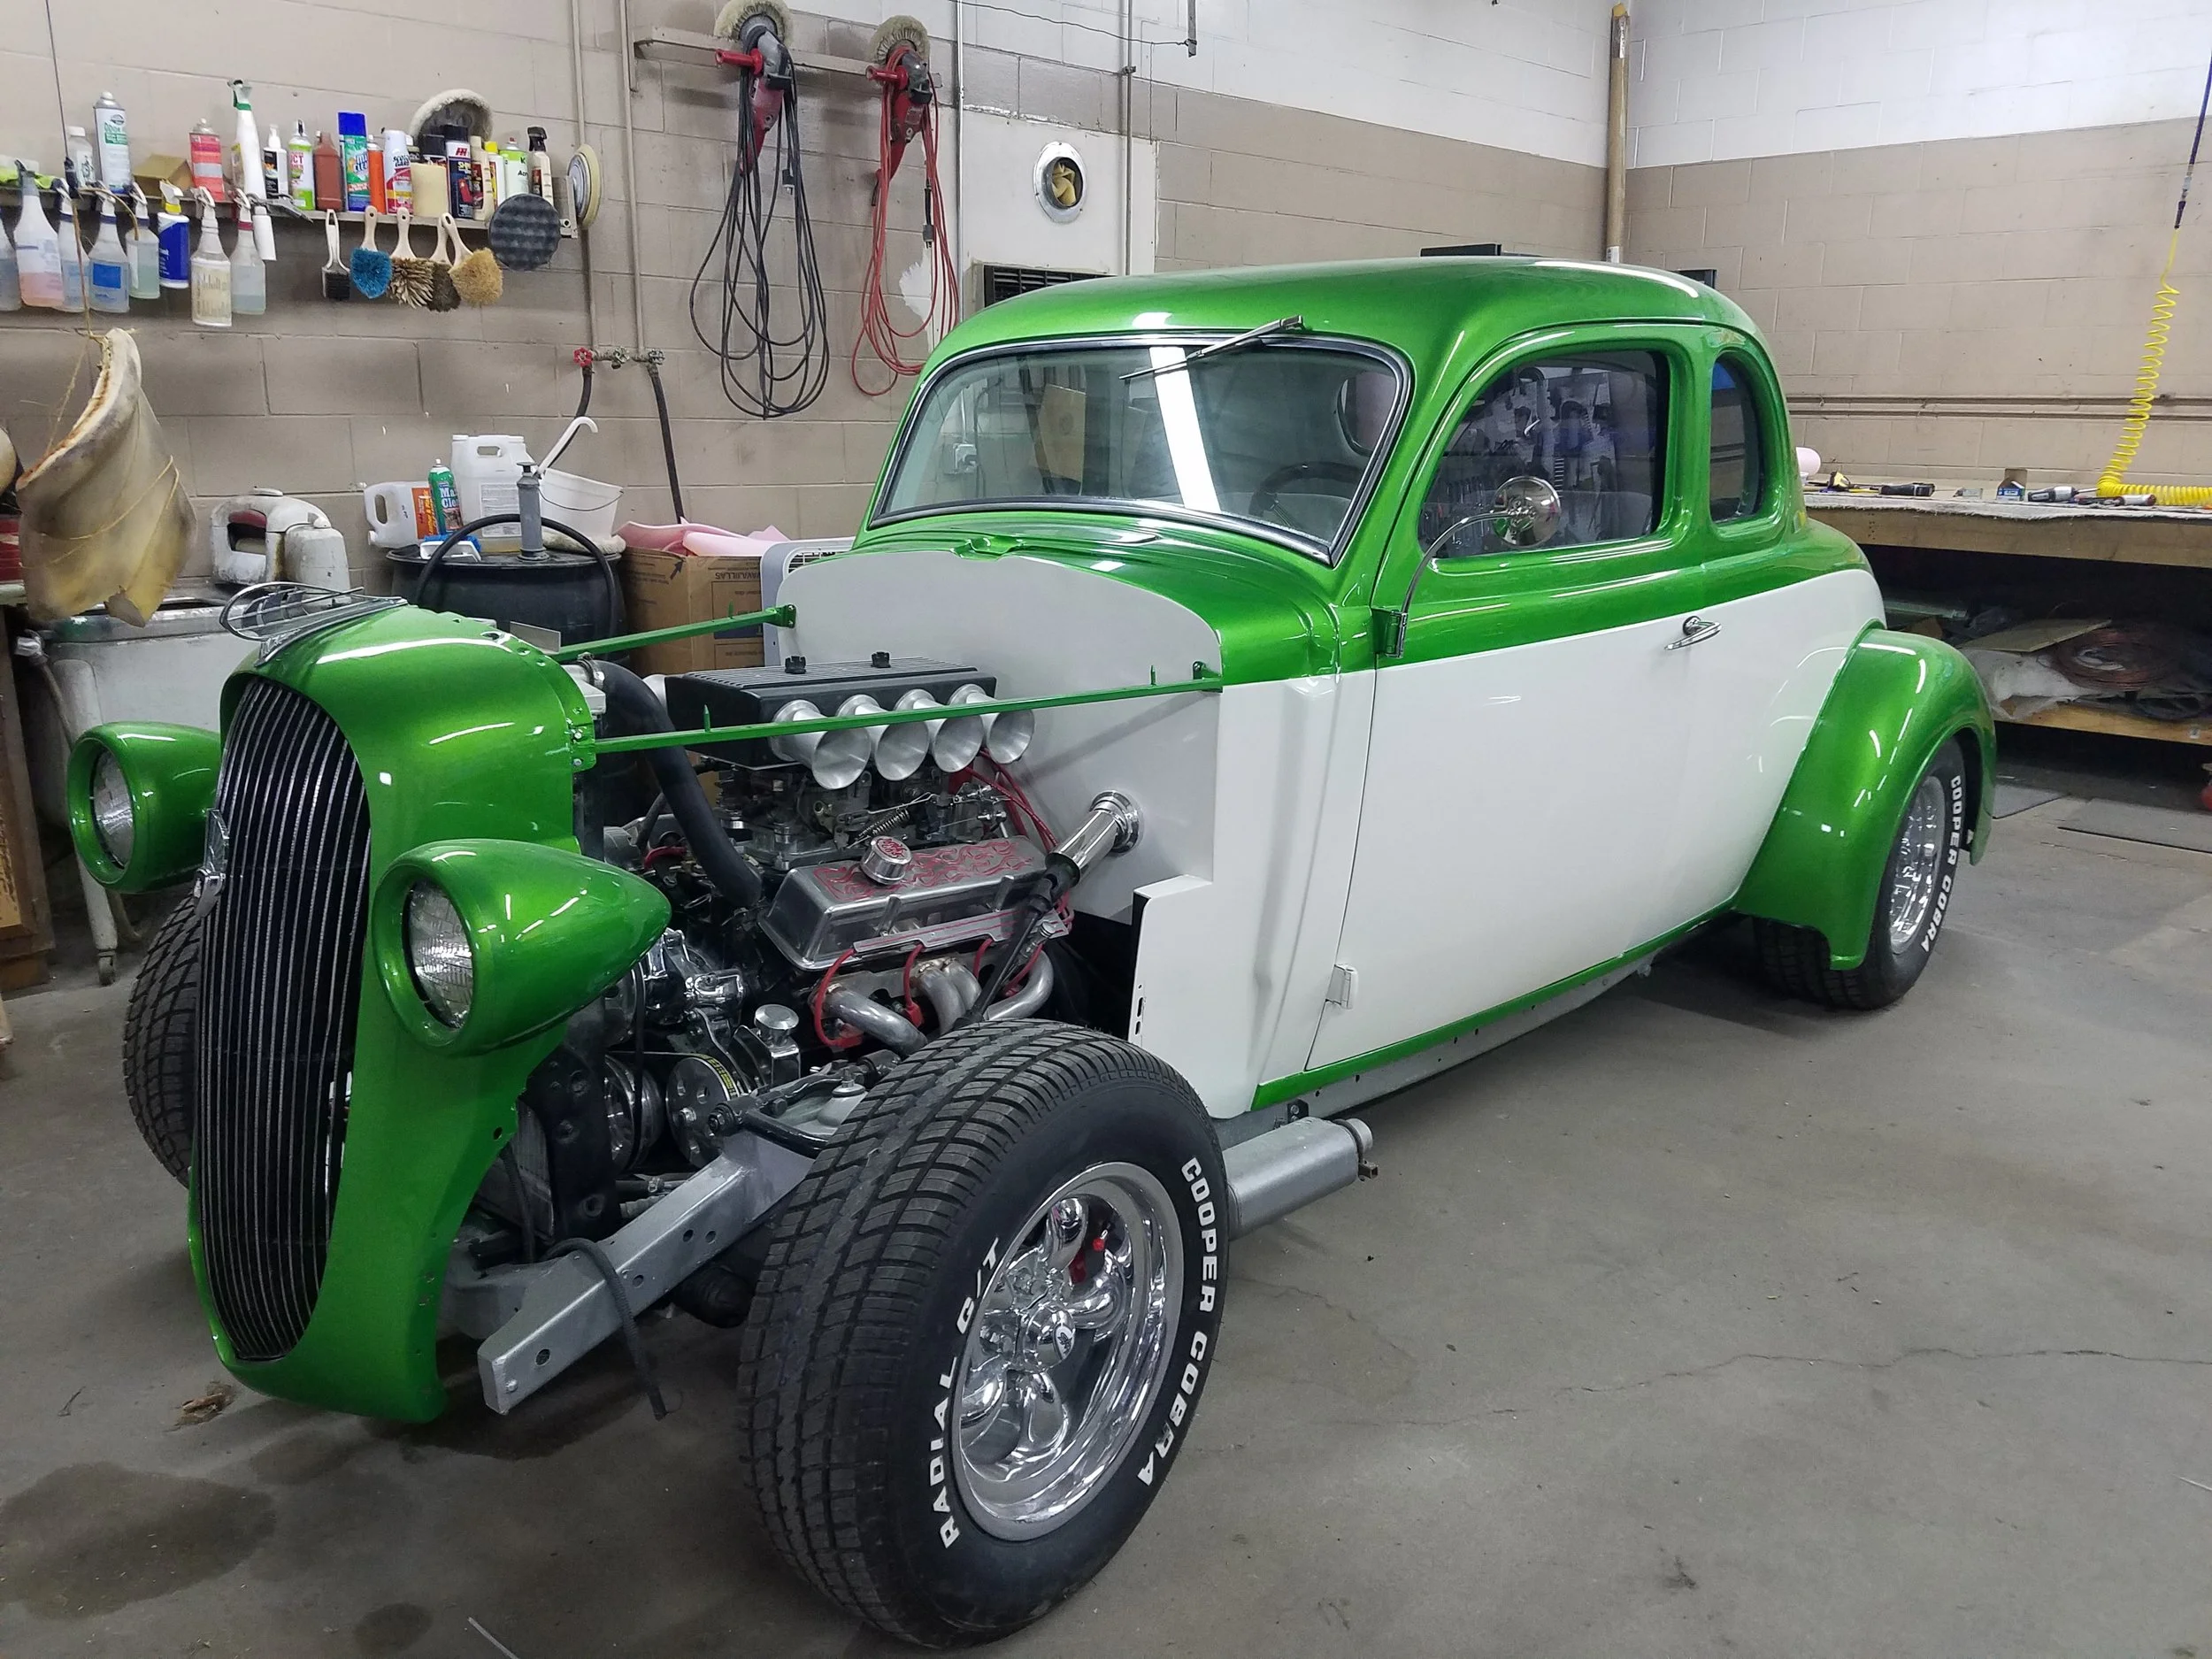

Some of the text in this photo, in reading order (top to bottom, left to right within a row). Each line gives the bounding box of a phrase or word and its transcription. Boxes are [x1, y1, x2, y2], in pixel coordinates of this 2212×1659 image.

[1921, 775, 1962, 953] COOPER COBRA
[1137, 1156, 1218, 1487] COOPER COBRA
[929, 1356, 960, 1548] RADIAL
